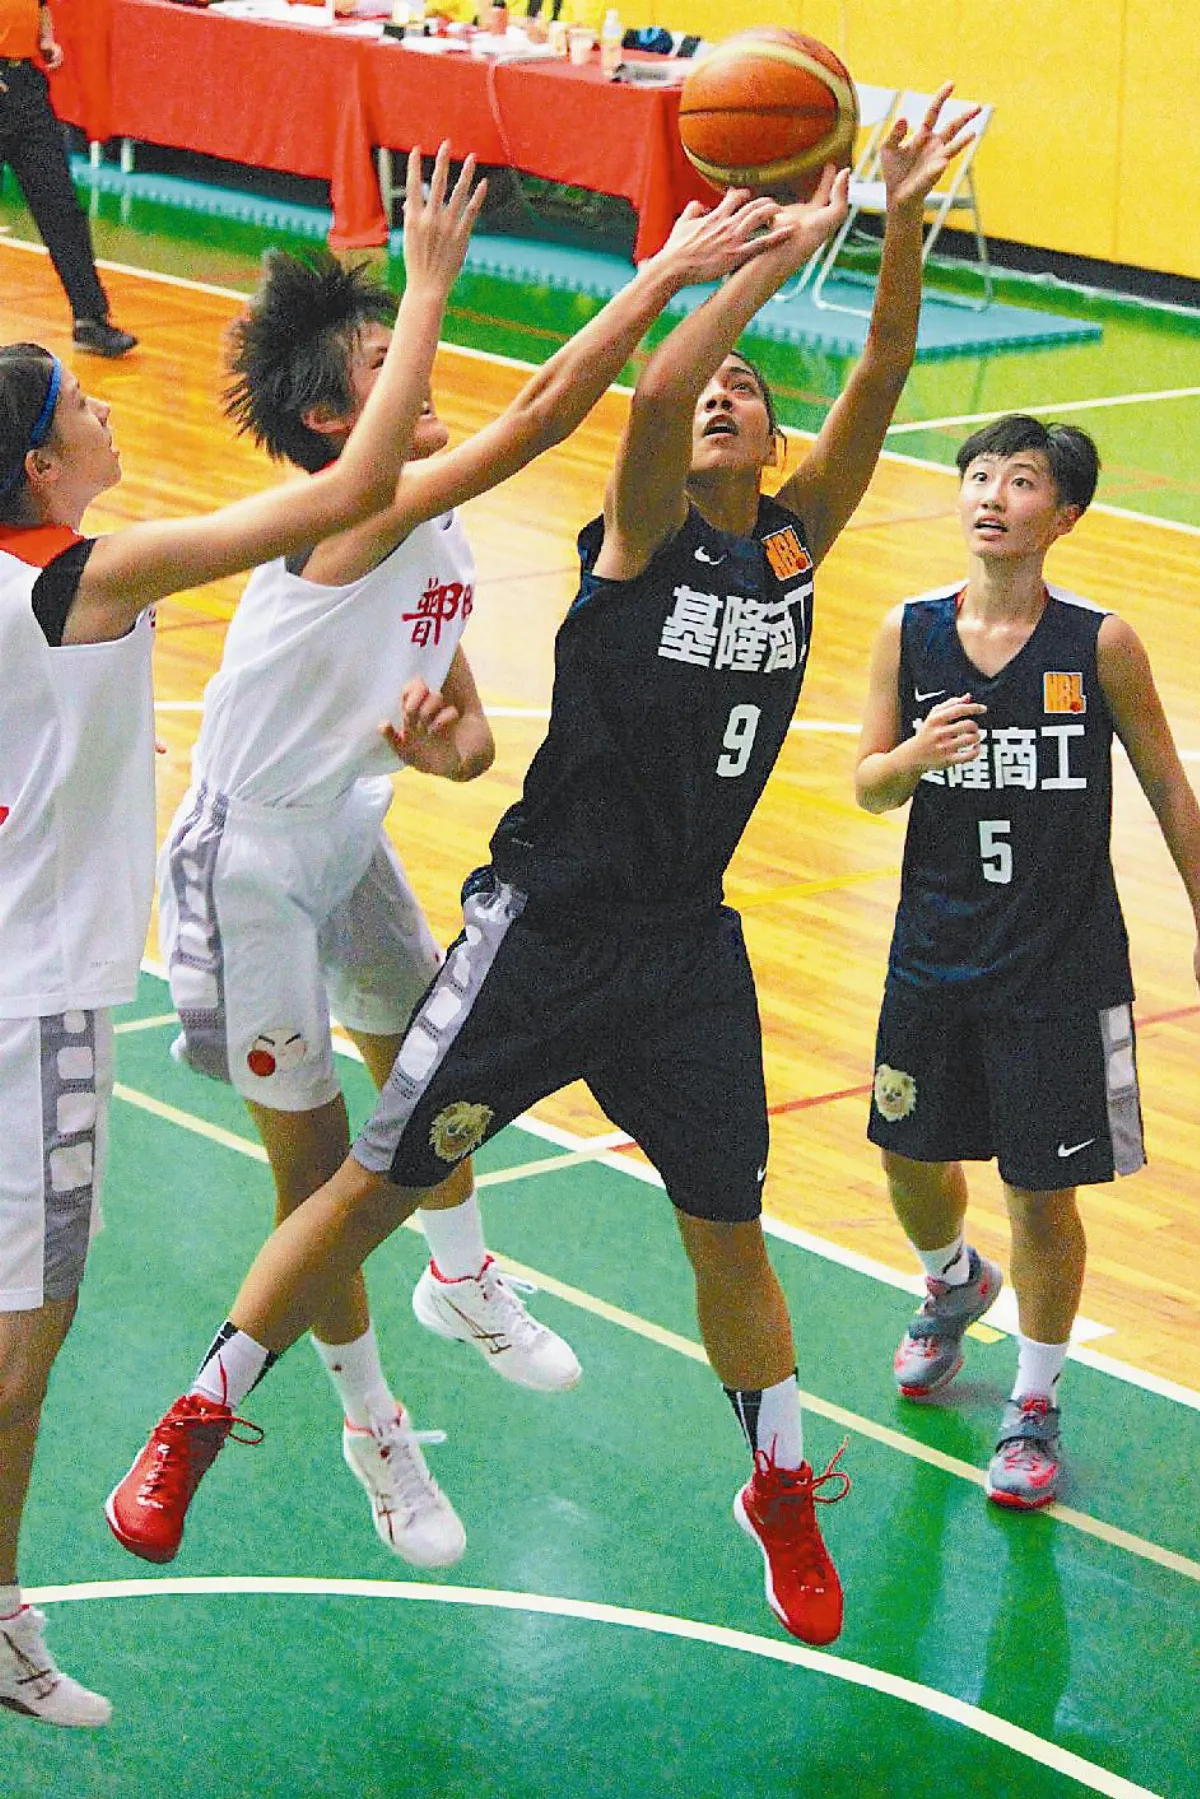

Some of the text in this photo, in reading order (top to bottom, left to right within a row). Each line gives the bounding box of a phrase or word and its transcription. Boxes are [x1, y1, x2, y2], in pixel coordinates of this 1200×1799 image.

[657, 581, 814, 674] 基隆商工
[716, 703, 761, 777] 9
[978, 820, 1013, 884] 5
